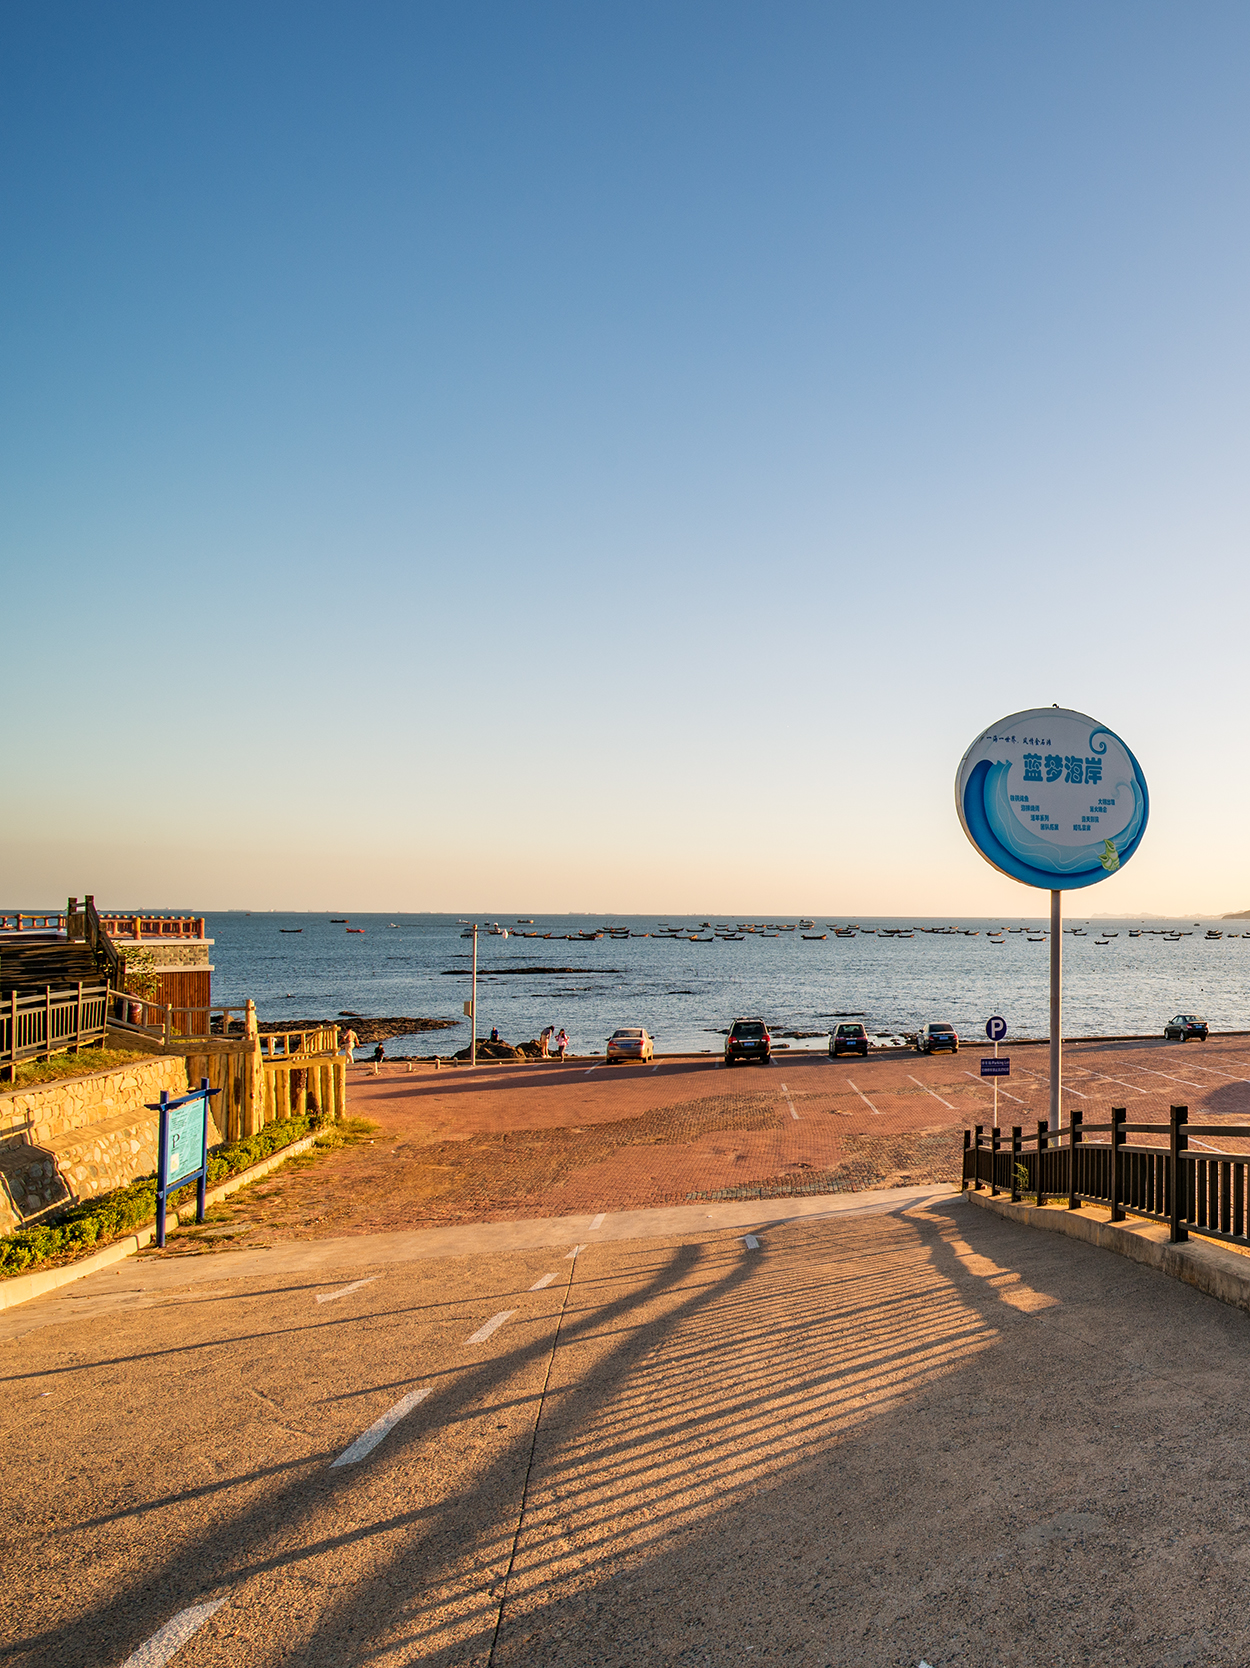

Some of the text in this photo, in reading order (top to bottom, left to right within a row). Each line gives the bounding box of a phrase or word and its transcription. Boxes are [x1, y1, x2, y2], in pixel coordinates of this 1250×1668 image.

[1023, 753, 1102, 784] 蓝梦海岸
[991, 1019, 1003, 1038] P
